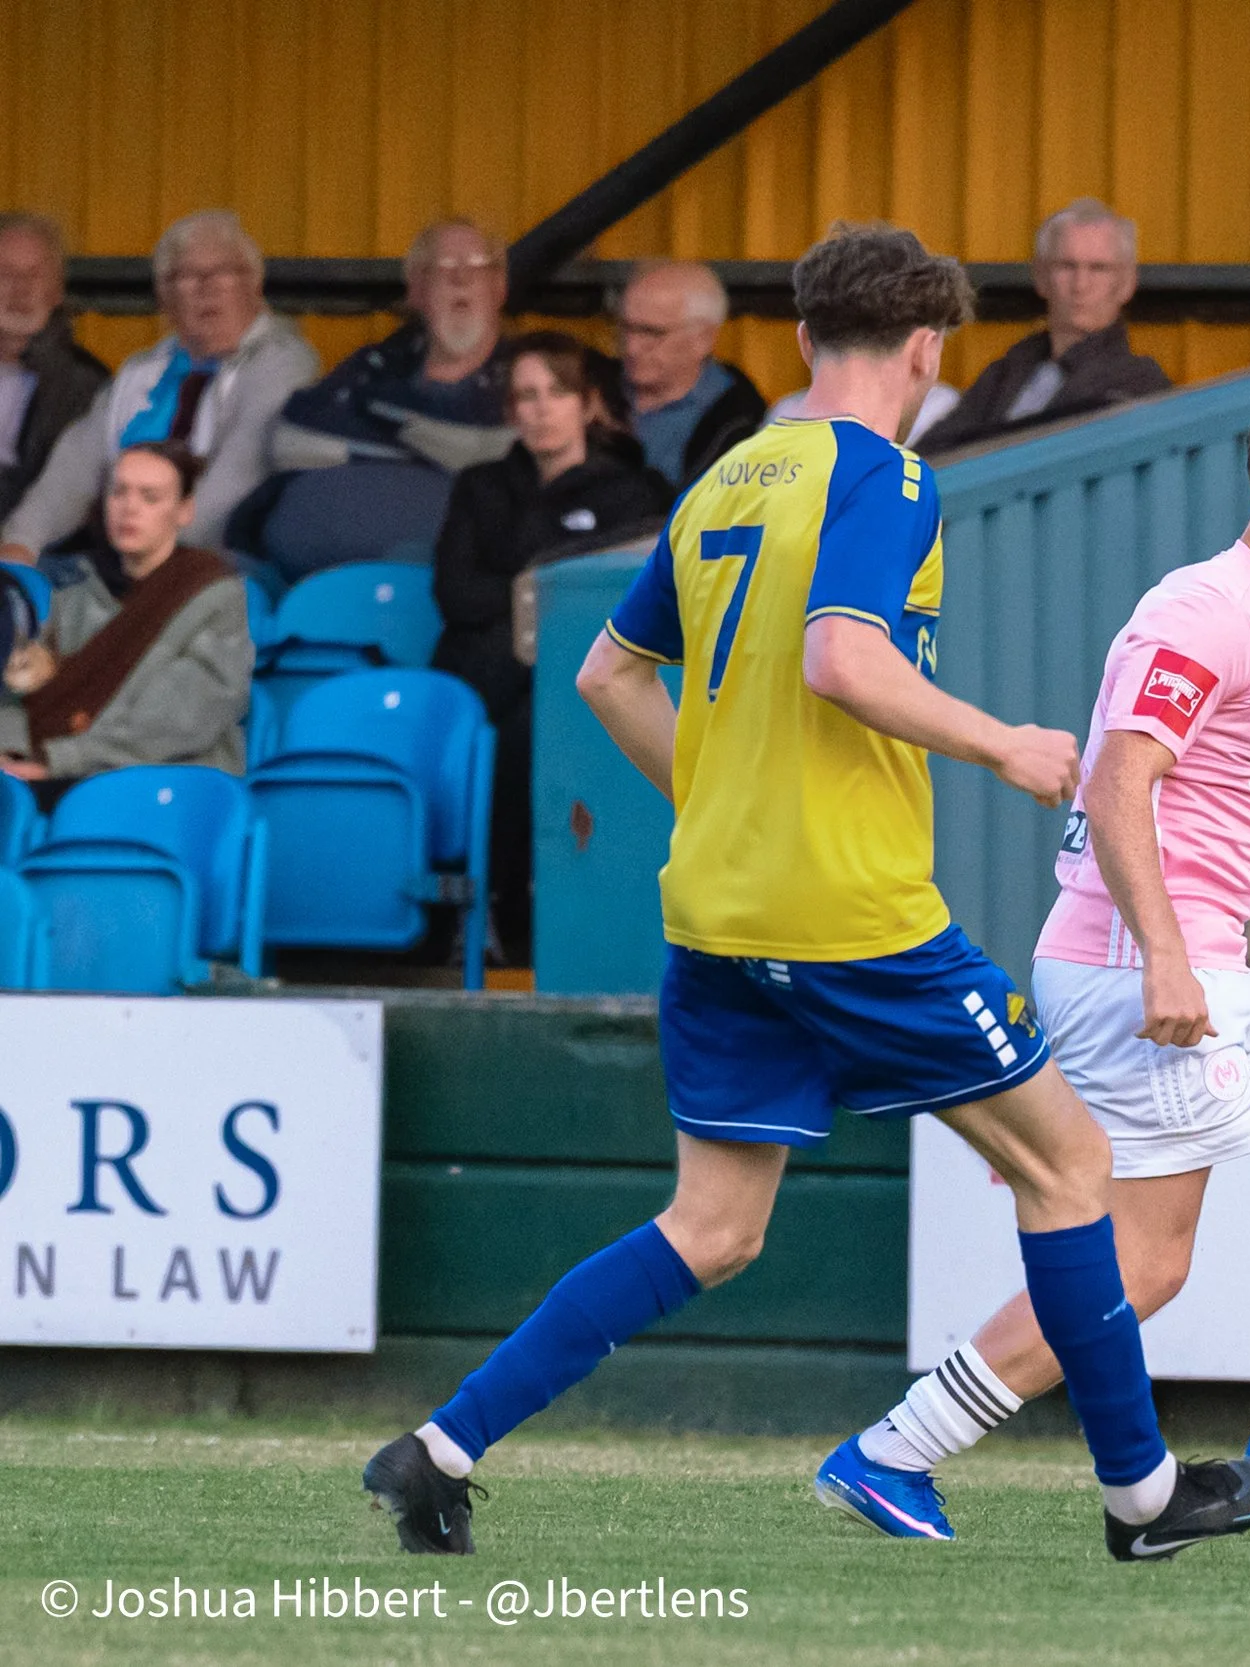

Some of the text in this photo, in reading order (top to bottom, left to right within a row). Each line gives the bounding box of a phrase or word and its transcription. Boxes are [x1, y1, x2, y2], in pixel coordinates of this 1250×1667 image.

[700, 523, 766, 703] 7
[0, 1098, 283, 1220] RS
[111, 1245, 281, 1304] LAW
